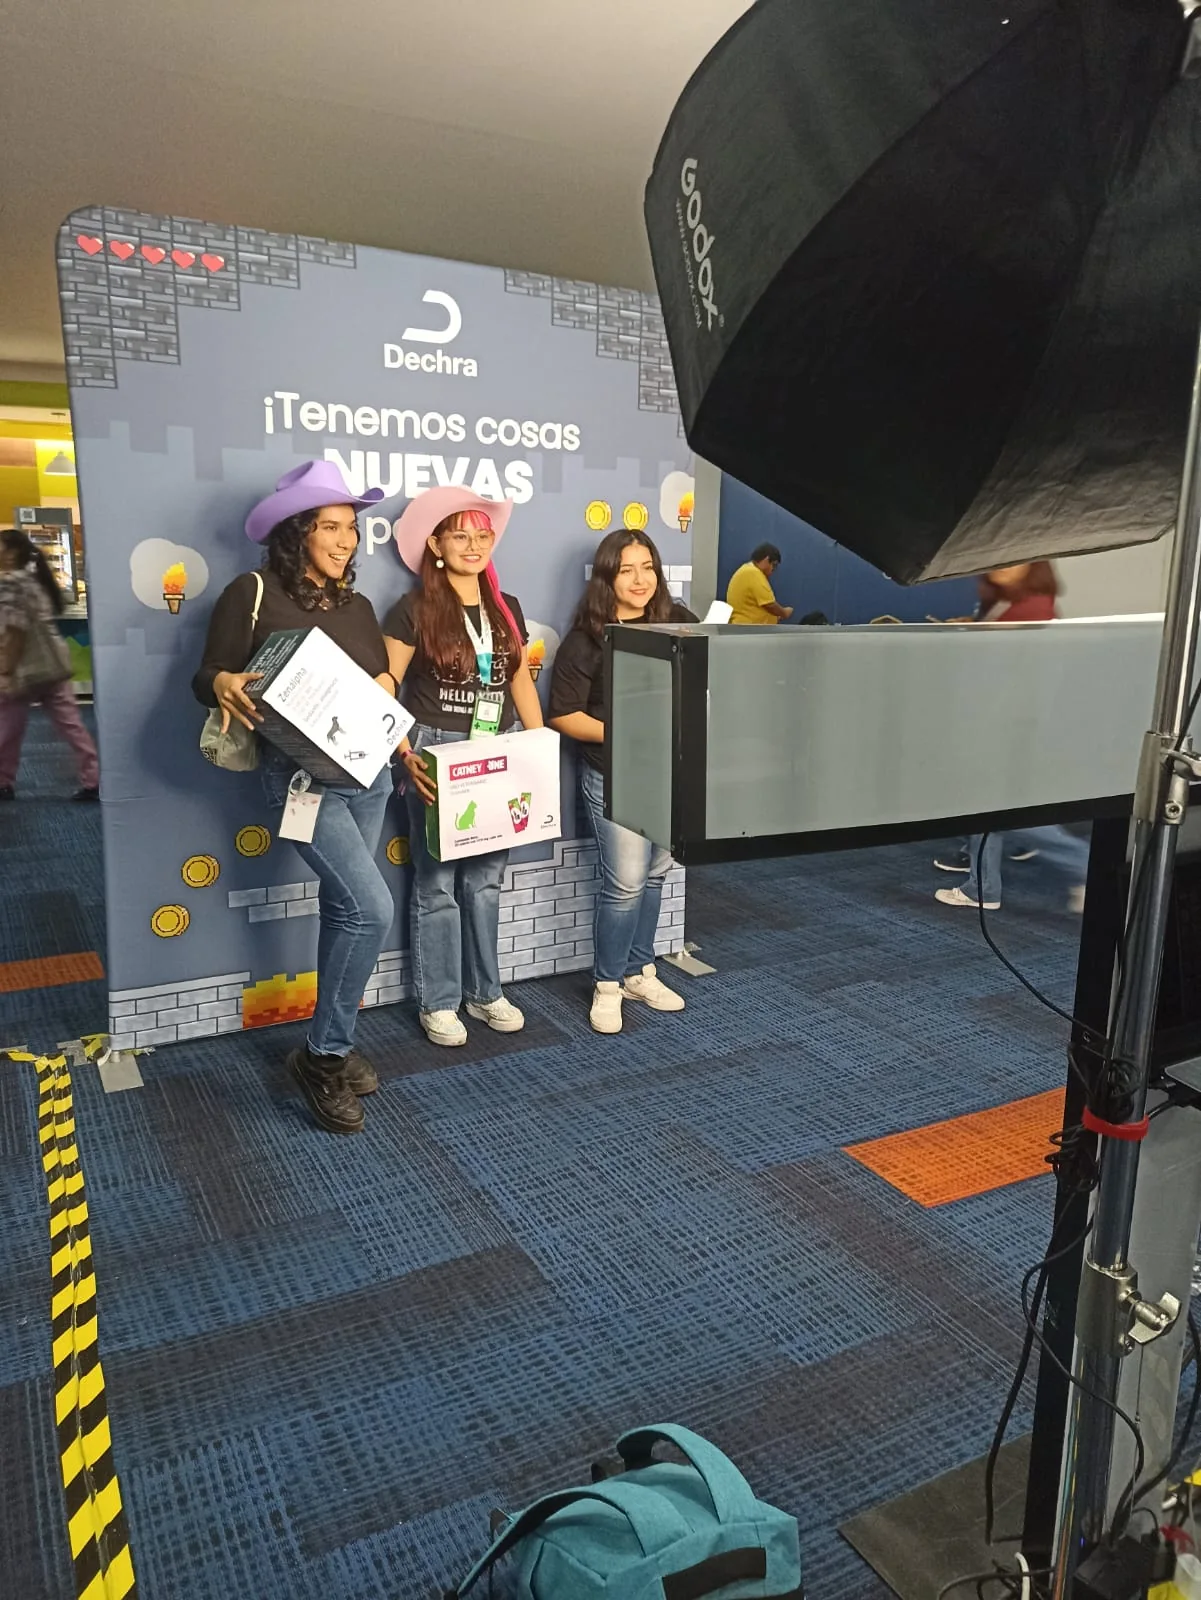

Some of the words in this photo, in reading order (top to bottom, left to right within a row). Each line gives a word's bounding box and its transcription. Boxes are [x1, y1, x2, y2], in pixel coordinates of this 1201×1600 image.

[384, 344, 478, 377] Dechra
[264, 391, 466, 442] ¡Tenemos
[475, 416, 581, 451] cosas
[324, 447, 534, 504] NUEVAS
[439, 687, 475, 703] HELLO
[452, 763, 483, 777] CATNEY
